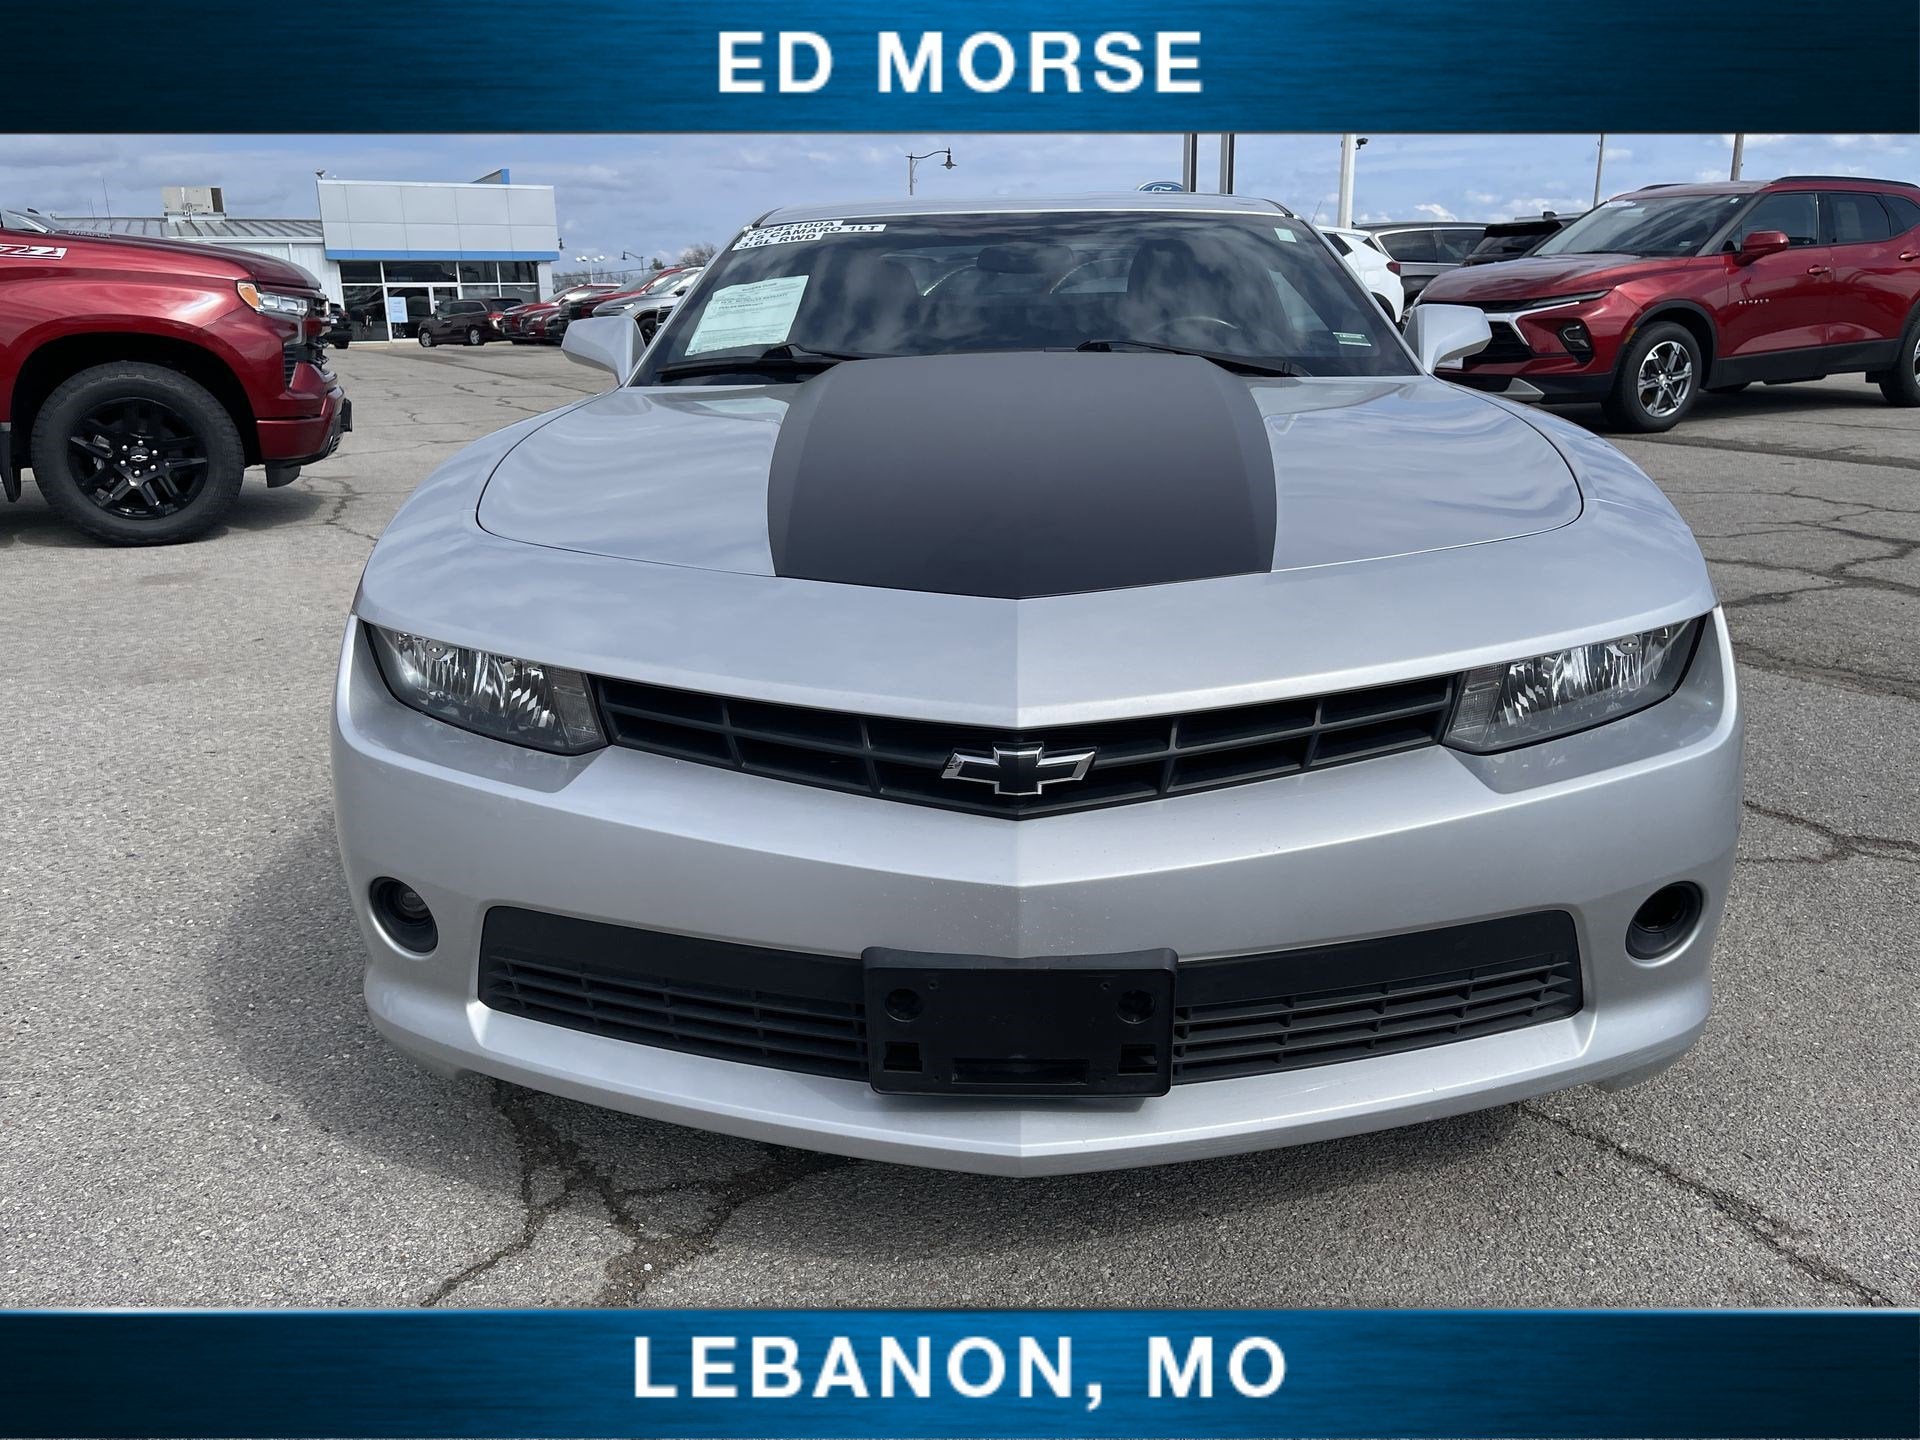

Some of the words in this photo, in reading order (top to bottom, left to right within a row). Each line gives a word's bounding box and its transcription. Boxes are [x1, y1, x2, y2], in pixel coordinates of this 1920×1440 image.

[770, 226, 842, 238] CAMARO
[738, 239, 773, 249] 3.6L
[778, 233, 817, 243] RWD
